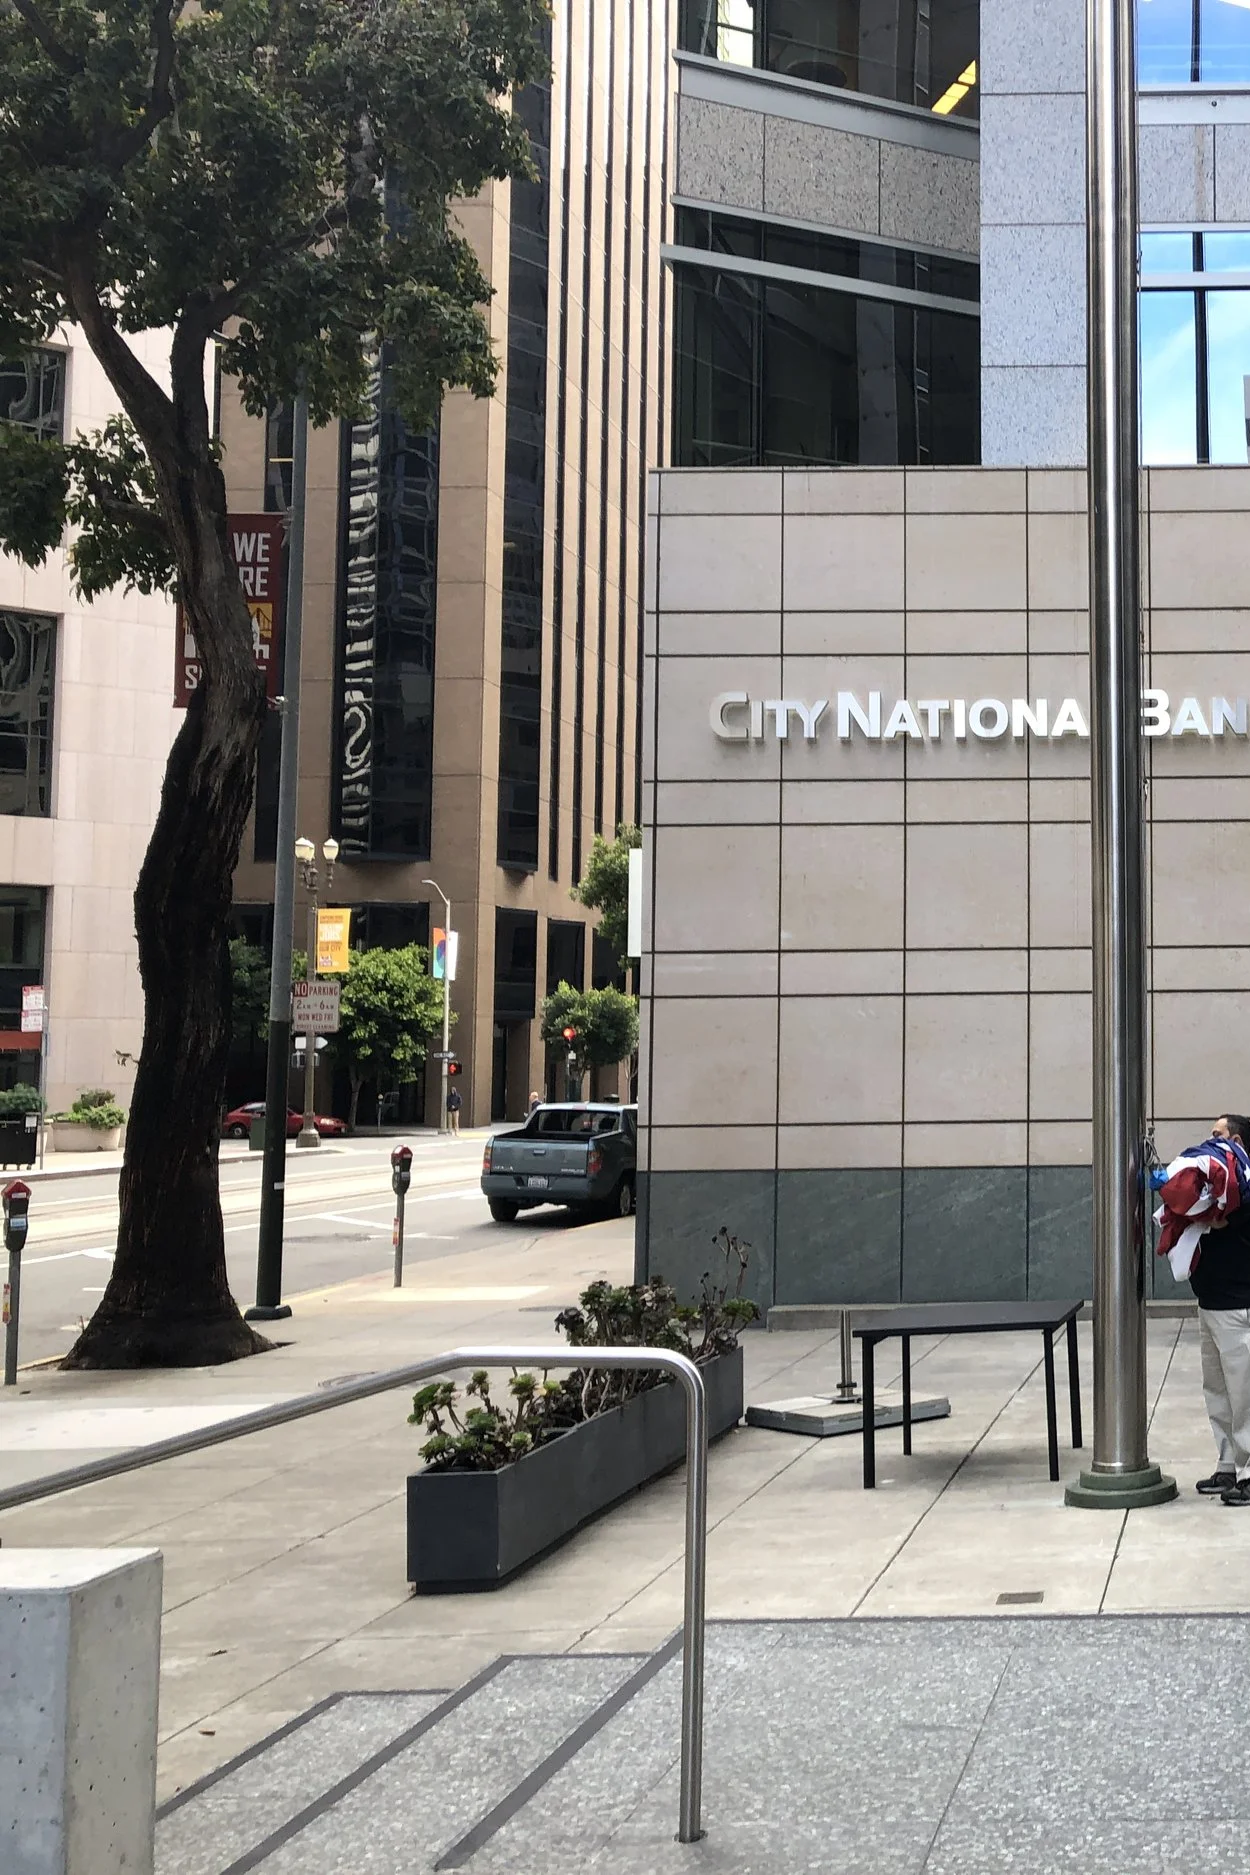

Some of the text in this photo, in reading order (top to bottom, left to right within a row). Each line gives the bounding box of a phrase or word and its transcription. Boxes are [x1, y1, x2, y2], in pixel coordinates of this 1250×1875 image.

[233, 532, 271, 562] WE
[239, 566, 269, 596] RE
[837, 690, 1090, 738] NATIONA
[294, 982, 338, 996] NO PARKING
[298, 1013, 310, 1021] MON
[312, 1013, 323, 1021] WED
